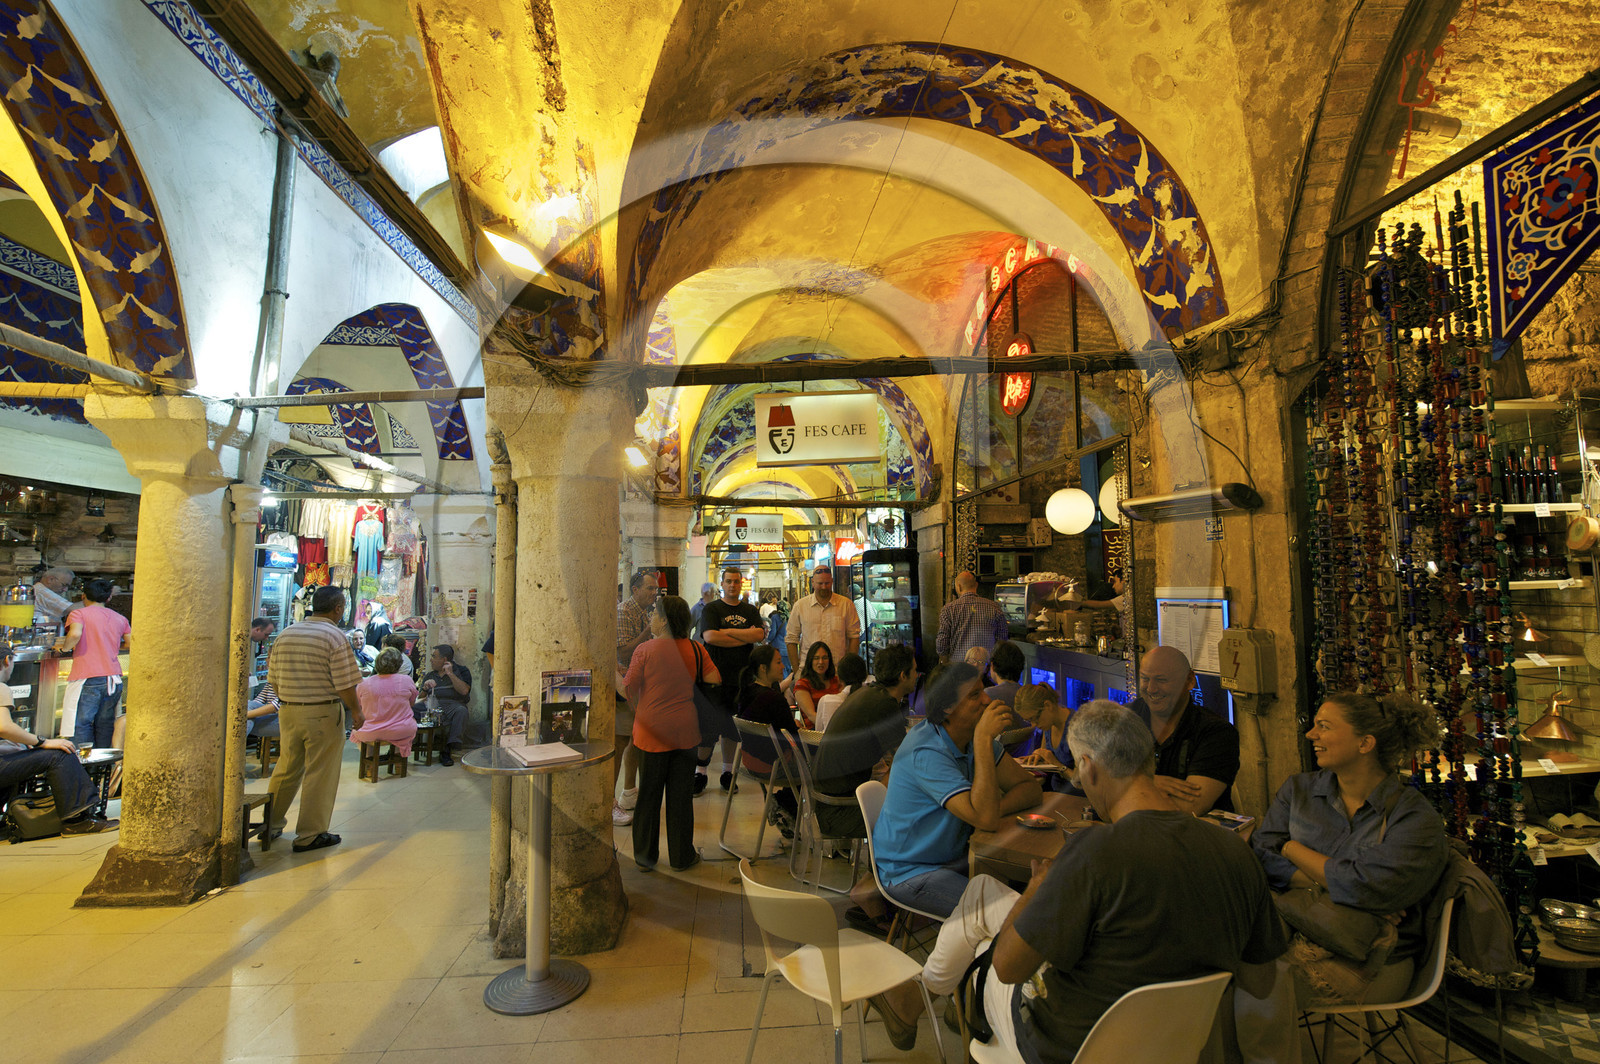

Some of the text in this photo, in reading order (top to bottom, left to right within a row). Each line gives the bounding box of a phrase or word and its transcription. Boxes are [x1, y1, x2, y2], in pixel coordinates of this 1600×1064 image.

[804, 423, 867, 438] FES CAFE
[1227, 638, 1244, 648] TEK
